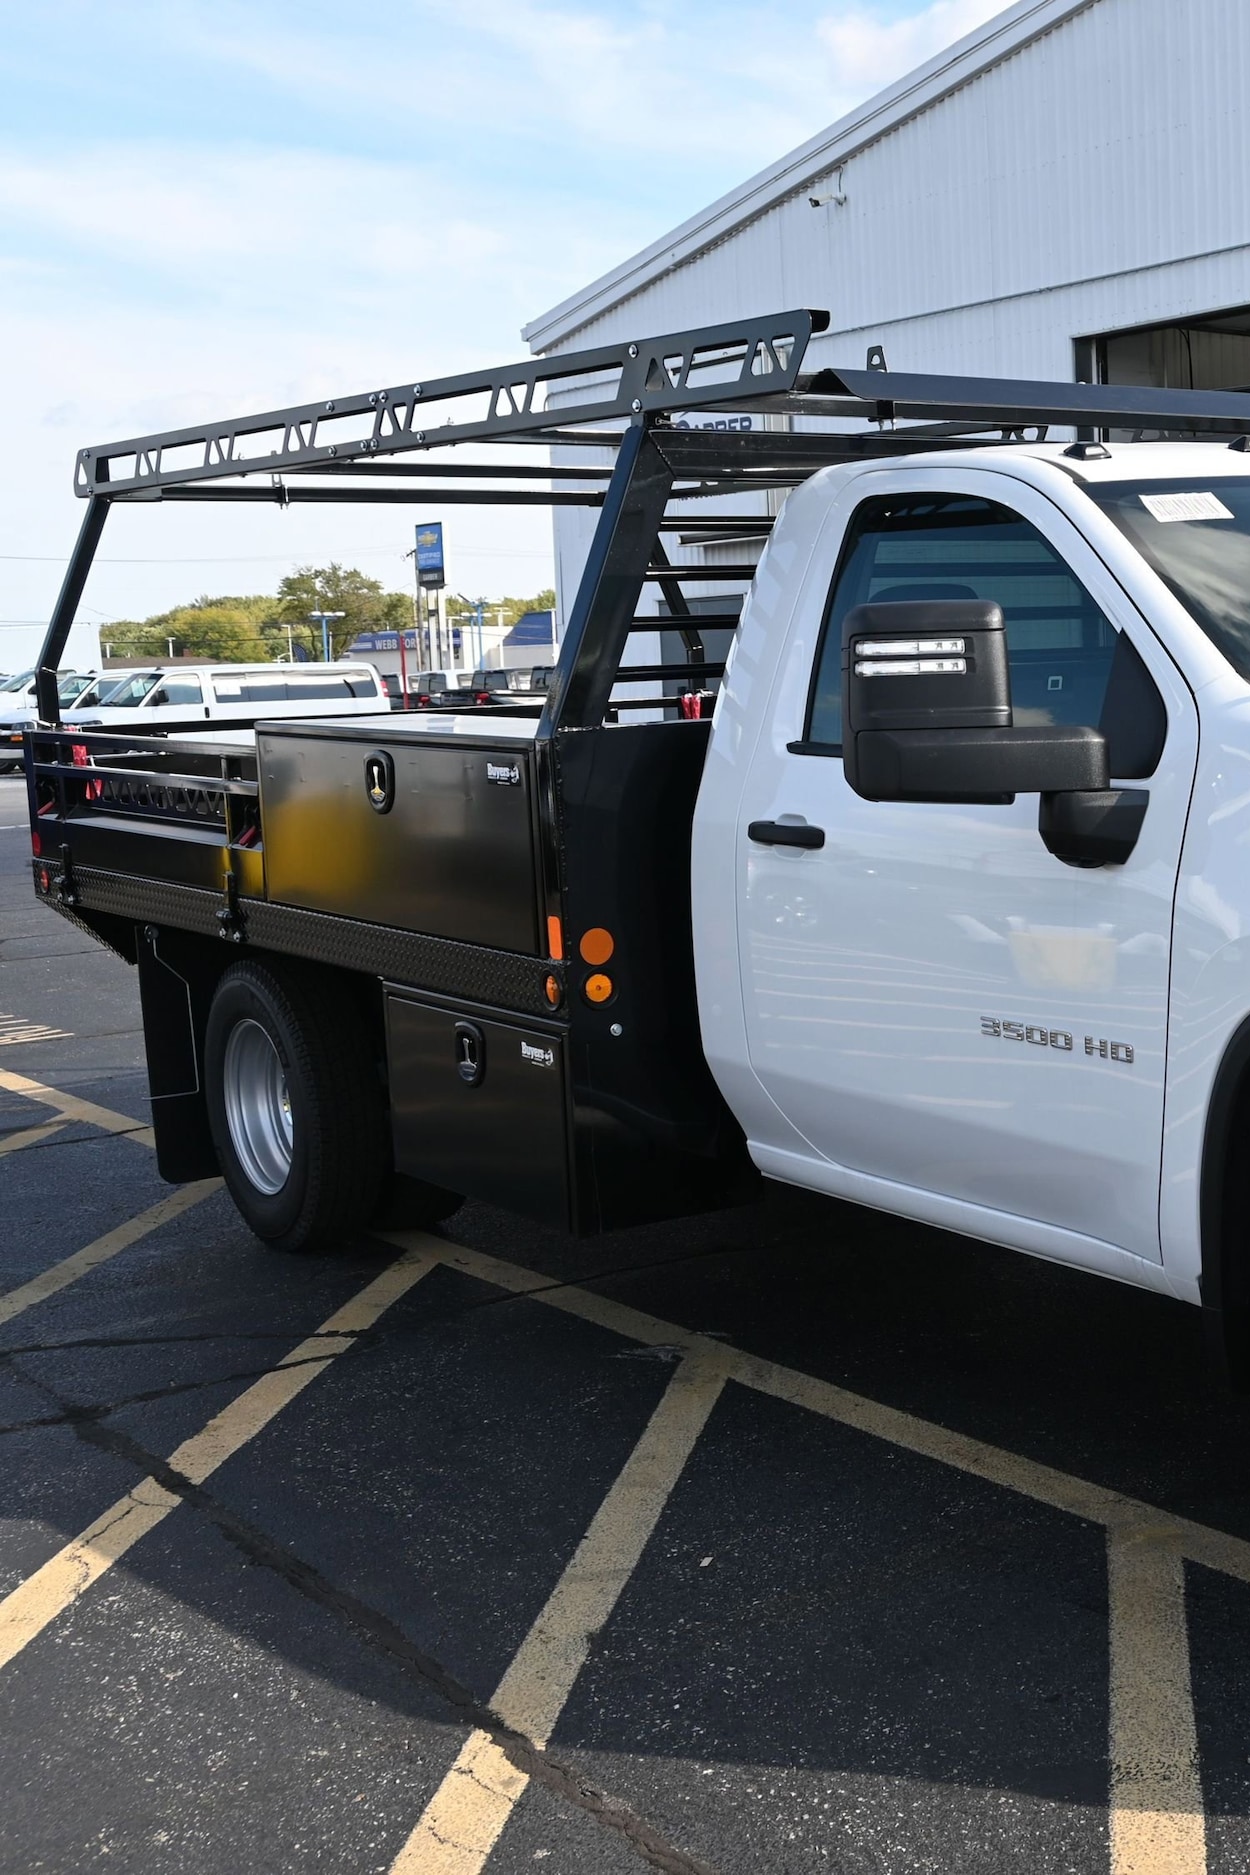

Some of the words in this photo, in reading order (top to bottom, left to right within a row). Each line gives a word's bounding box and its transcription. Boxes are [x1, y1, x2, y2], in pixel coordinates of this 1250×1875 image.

[374, 638, 397, 650] WEBB
[402, 637, 417, 649] OR
[487, 763, 510, 779] Buyers
[980, 1015, 1073, 1051] 3500
[1084, 1035, 1134, 1063] HD
[521, 1041, 545, 1059] Buyers
